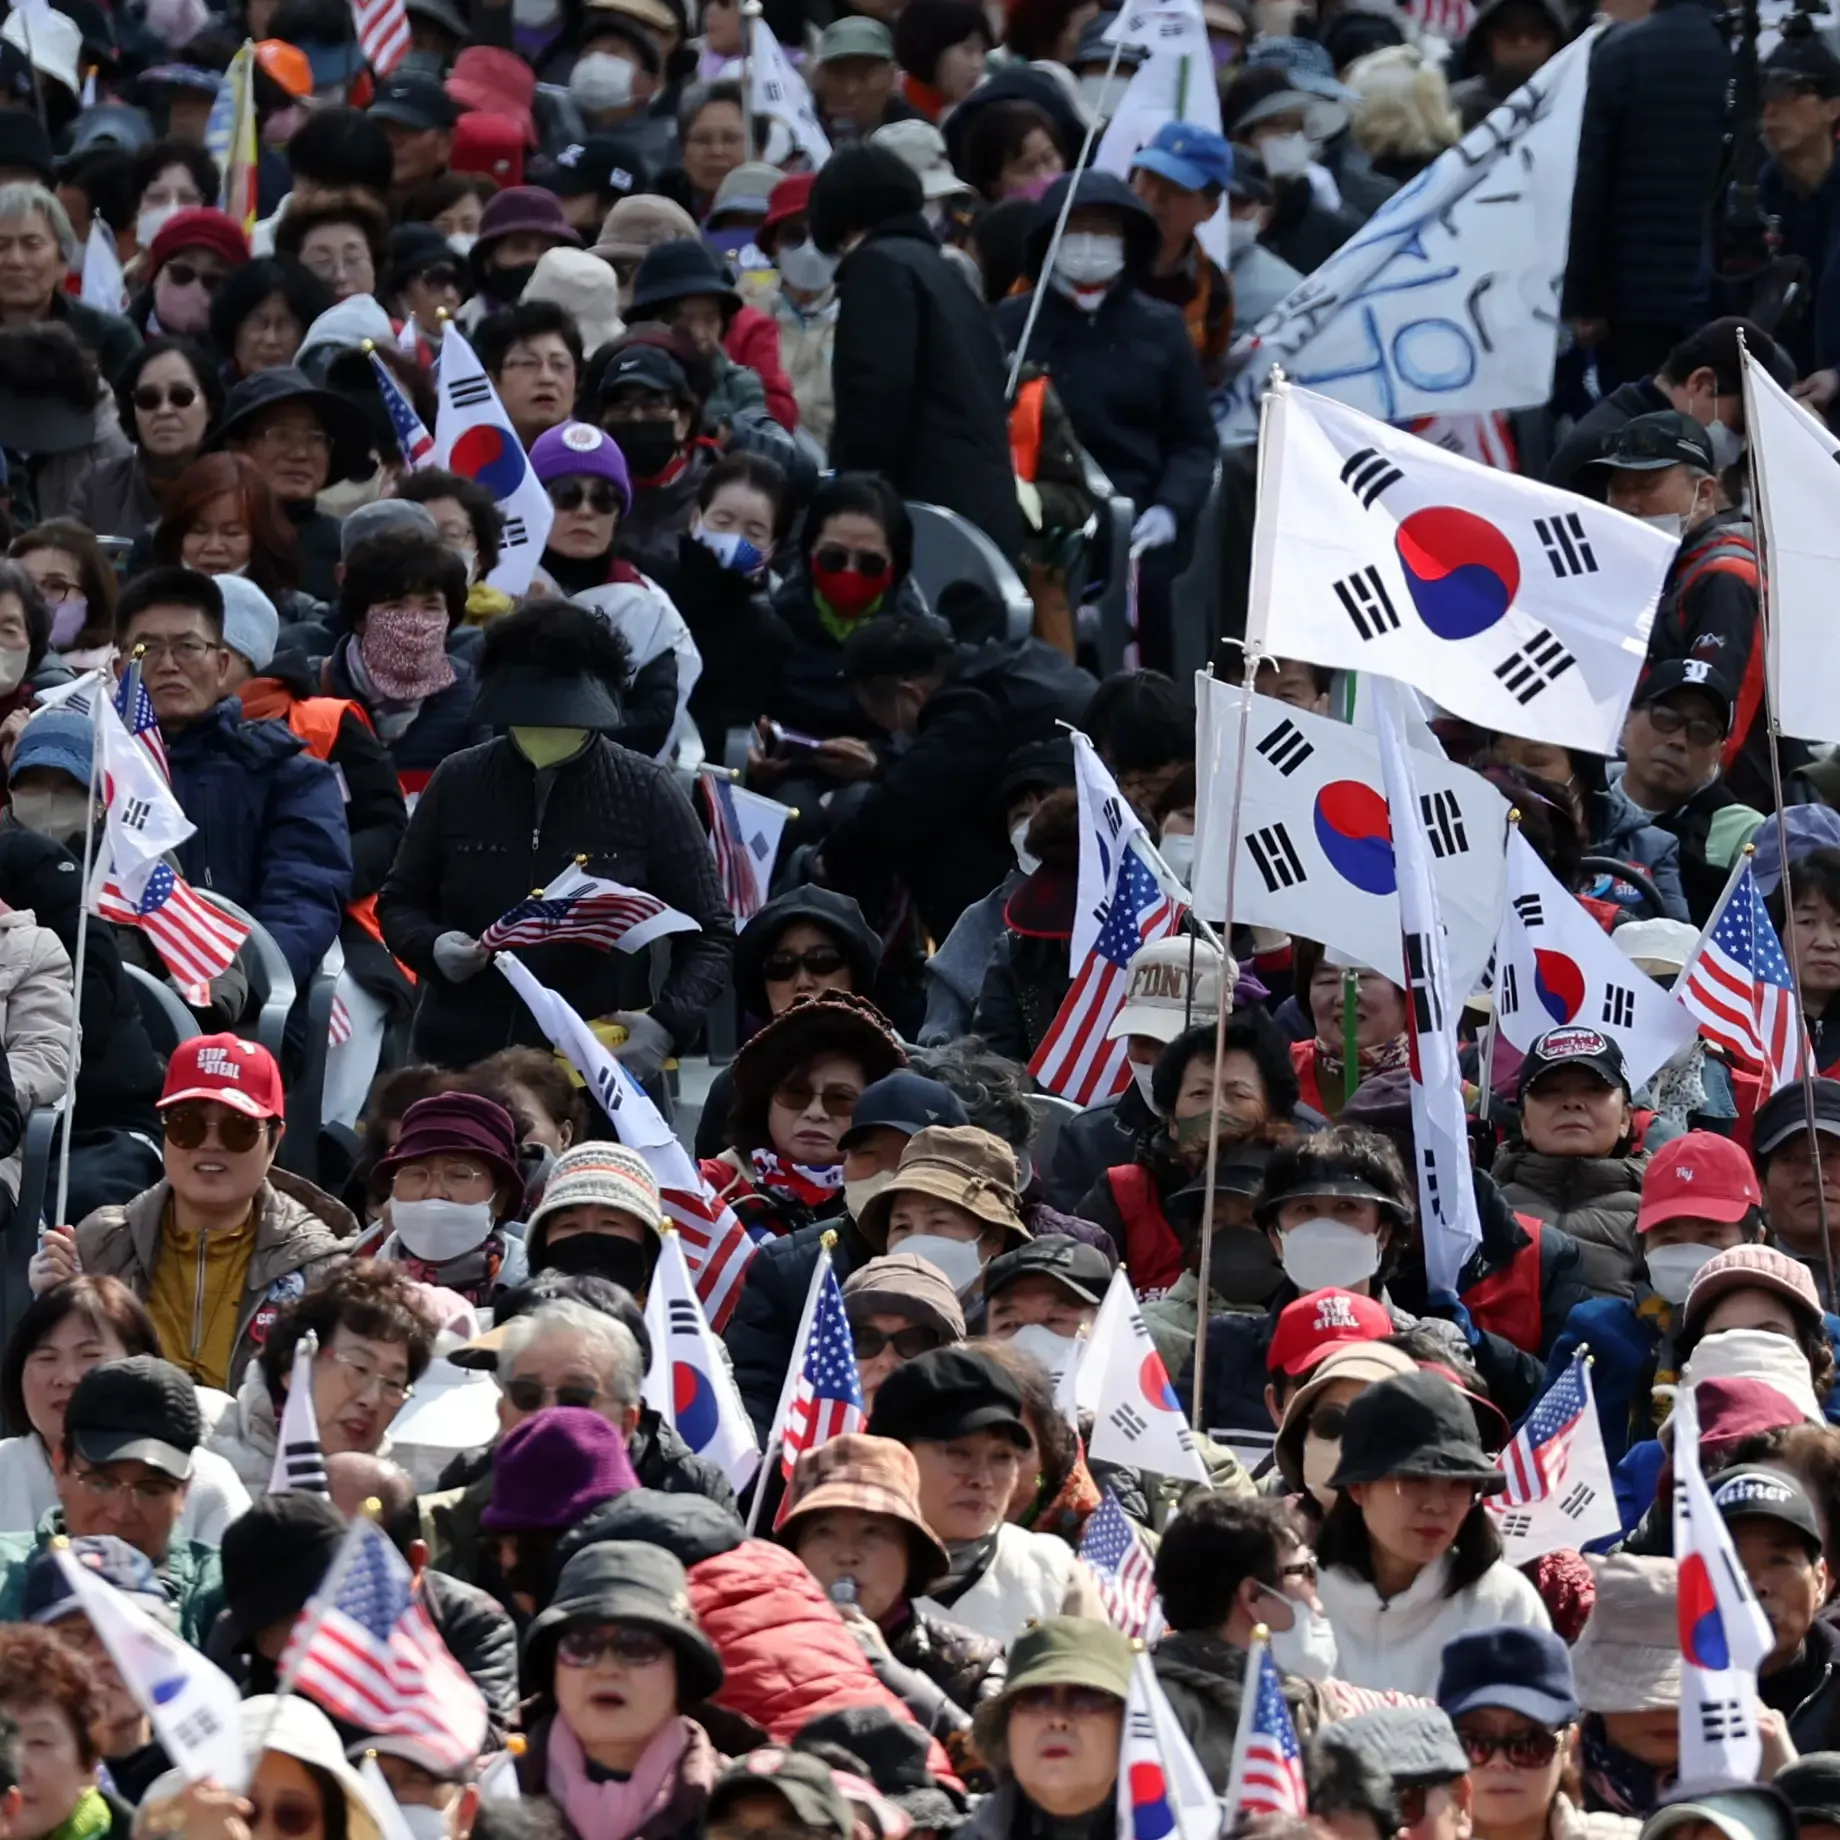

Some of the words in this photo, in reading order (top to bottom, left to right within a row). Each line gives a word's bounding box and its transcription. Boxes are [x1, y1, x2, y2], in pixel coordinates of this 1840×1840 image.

[1129, 962, 1203, 1002] FDNY
[197, 1048, 227, 1062] STOP
[204, 1061, 240, 1079] STEAL
[1316, 1296, 1351, 1310] STOP
[1323, 1306, 1349, 1317] THE
[1313, 1316, 1360, 1330] STEAL
